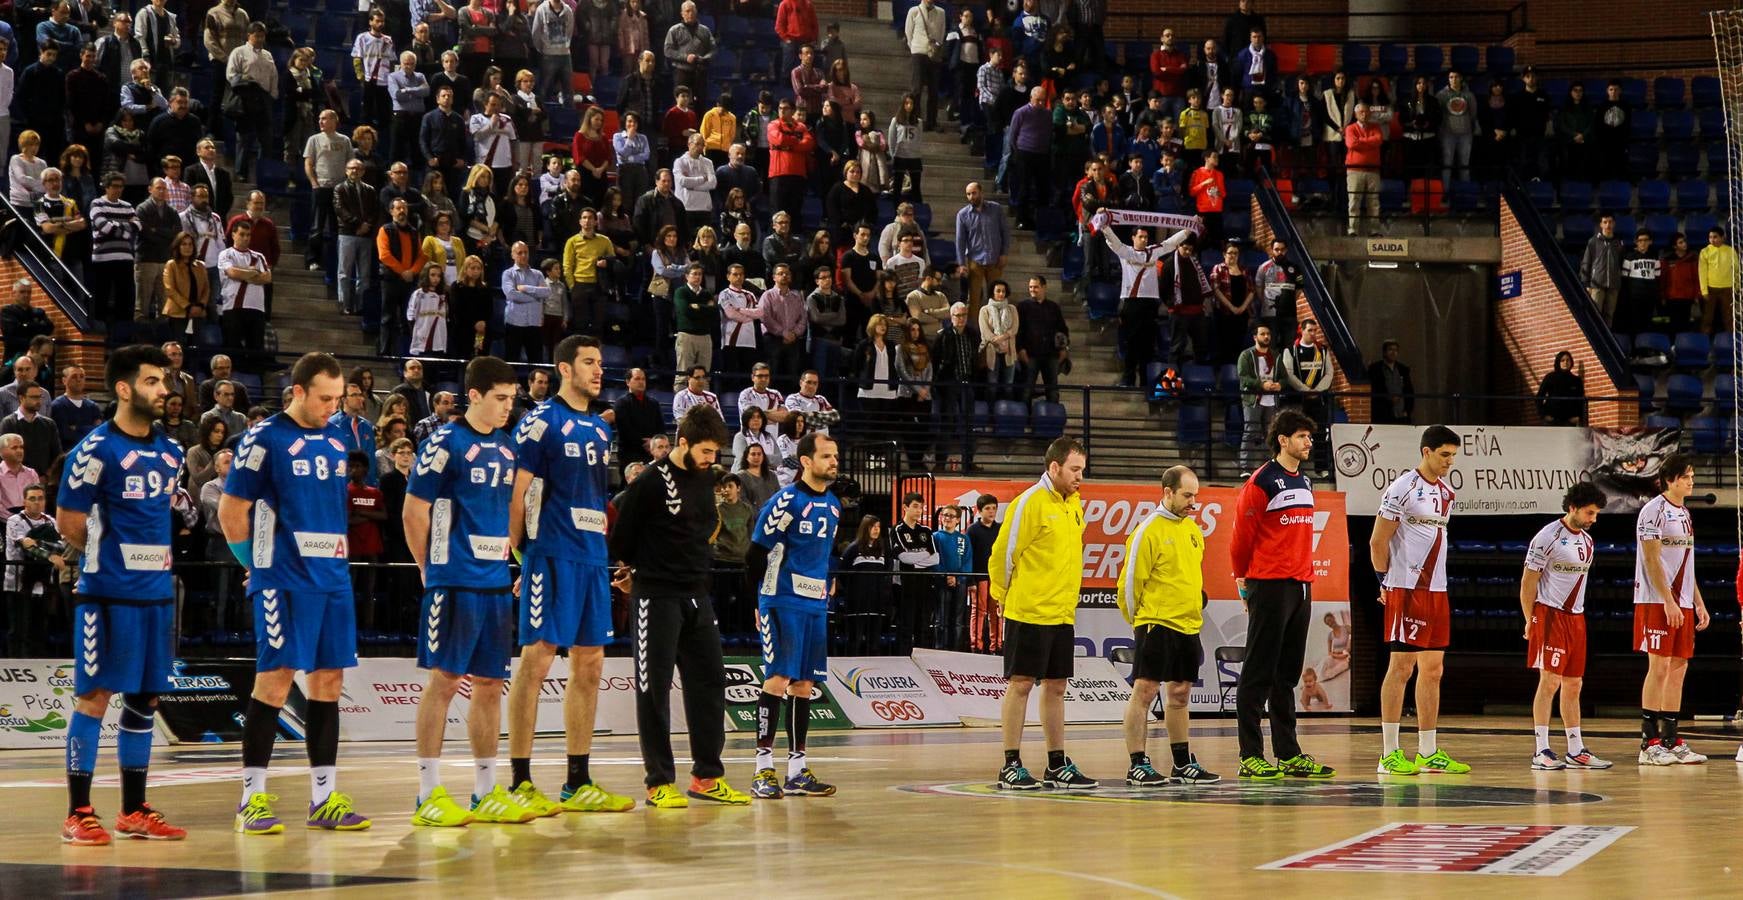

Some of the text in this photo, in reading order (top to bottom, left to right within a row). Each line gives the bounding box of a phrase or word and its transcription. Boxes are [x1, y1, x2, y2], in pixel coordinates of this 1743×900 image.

[1122, 213, 1159, 224] ORGULLO
[1372, 243, 1404, 252] SALIDA
[1463, 427, 1502, 456] EÑA
[585, 441, 597, 466] 6
[315, 455, 328, 480] 8
[488, 462, 500, 487] 7
[148, 471, 161, 498] 9
[1275, 479, 1286, 489] 12
[1433, 498, 1440, 513] 2
[817, 517, 826, 538] 2
[1578, 547, 1584, 561] 6
[1408, 624, 1418, 640] 2
[1650, 634, 1660, 650] 11
[1551, 652, 1560, 667] 6
[725, 672, 751, 681] NDA
[864, 676, 919, 689] VIGUERA
[948, 670, 1009, 685] Ayuntamie
[1068, 678, 1118, 689] Gobierno
[372, 683, 423, 693] AUTO
[958, 685, 974, 695] de
[22, 693, 65, 710] Pisa
[1079, 692, 1094, 702] de
[1093, 692, 1110, 702] La
[819, 709, 836, 719] FM
[873, 702, 920, 718] TNT
